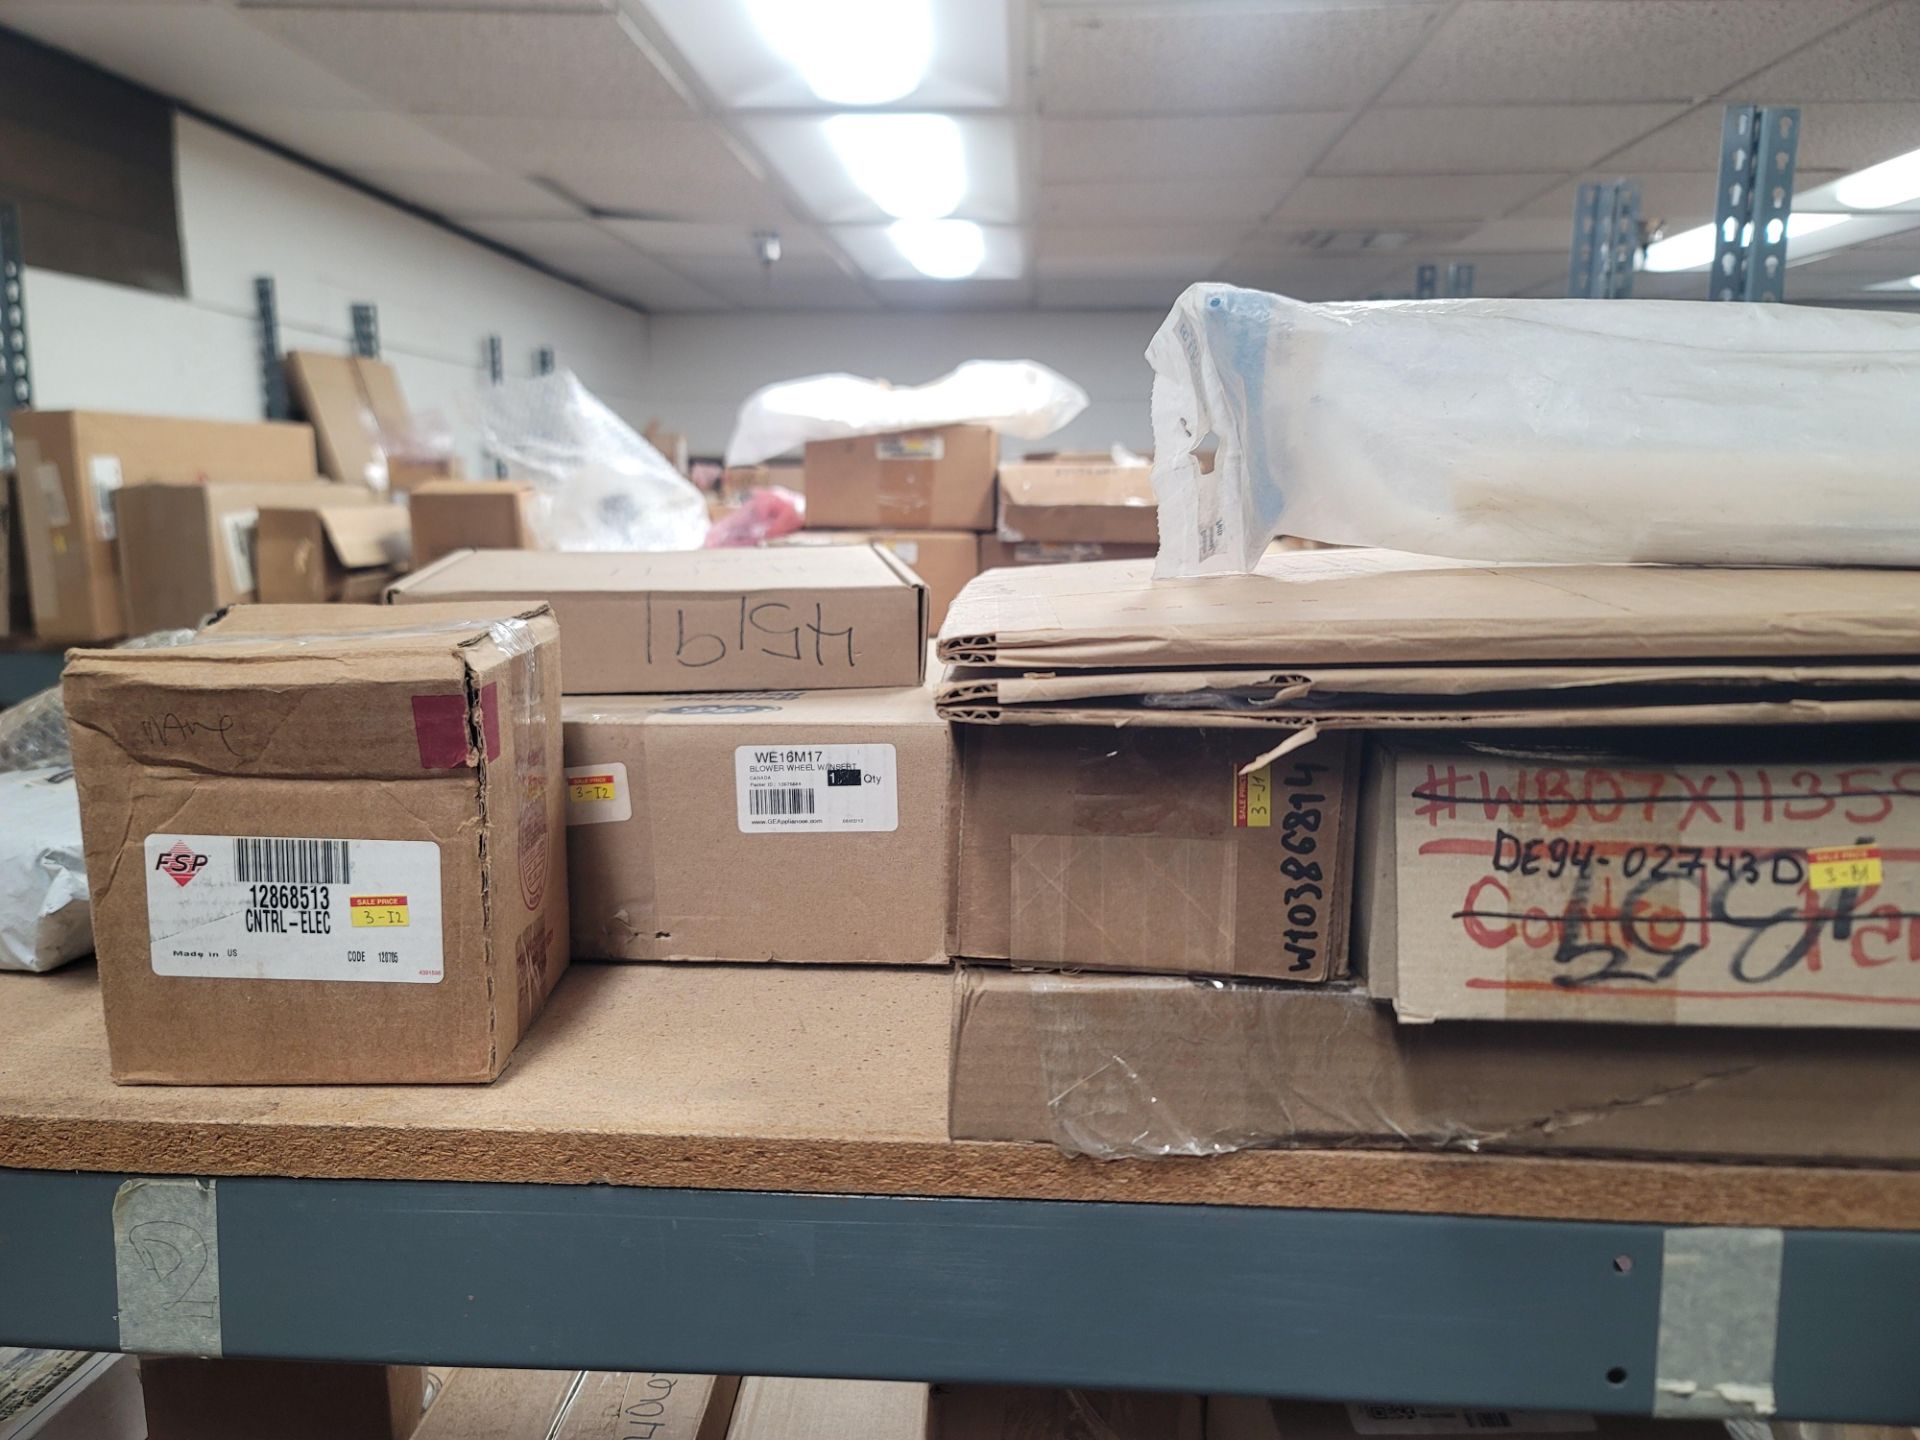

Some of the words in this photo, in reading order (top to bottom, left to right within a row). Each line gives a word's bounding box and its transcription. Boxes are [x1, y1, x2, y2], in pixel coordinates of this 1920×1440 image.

[754, 750, 823, 764] WE16M17
[749, 764, 785, 773] BLOWER
[786, 763, 815, 772] WHEEL
[863, 773, 882, 786] Qty
[155, 852, 209, 872] FSP
[1279, 762, 1330, 973] W10386814
[249, 884, 330, 910] 12868513
[356, 898, 376, 906] SALE
[377, 897, 400, 905] PRICE
[245, 909, 332, 934] CNTRL-ELEC
[227, 947, 238, 958] US
[347, 951, 366, 963] CODE
